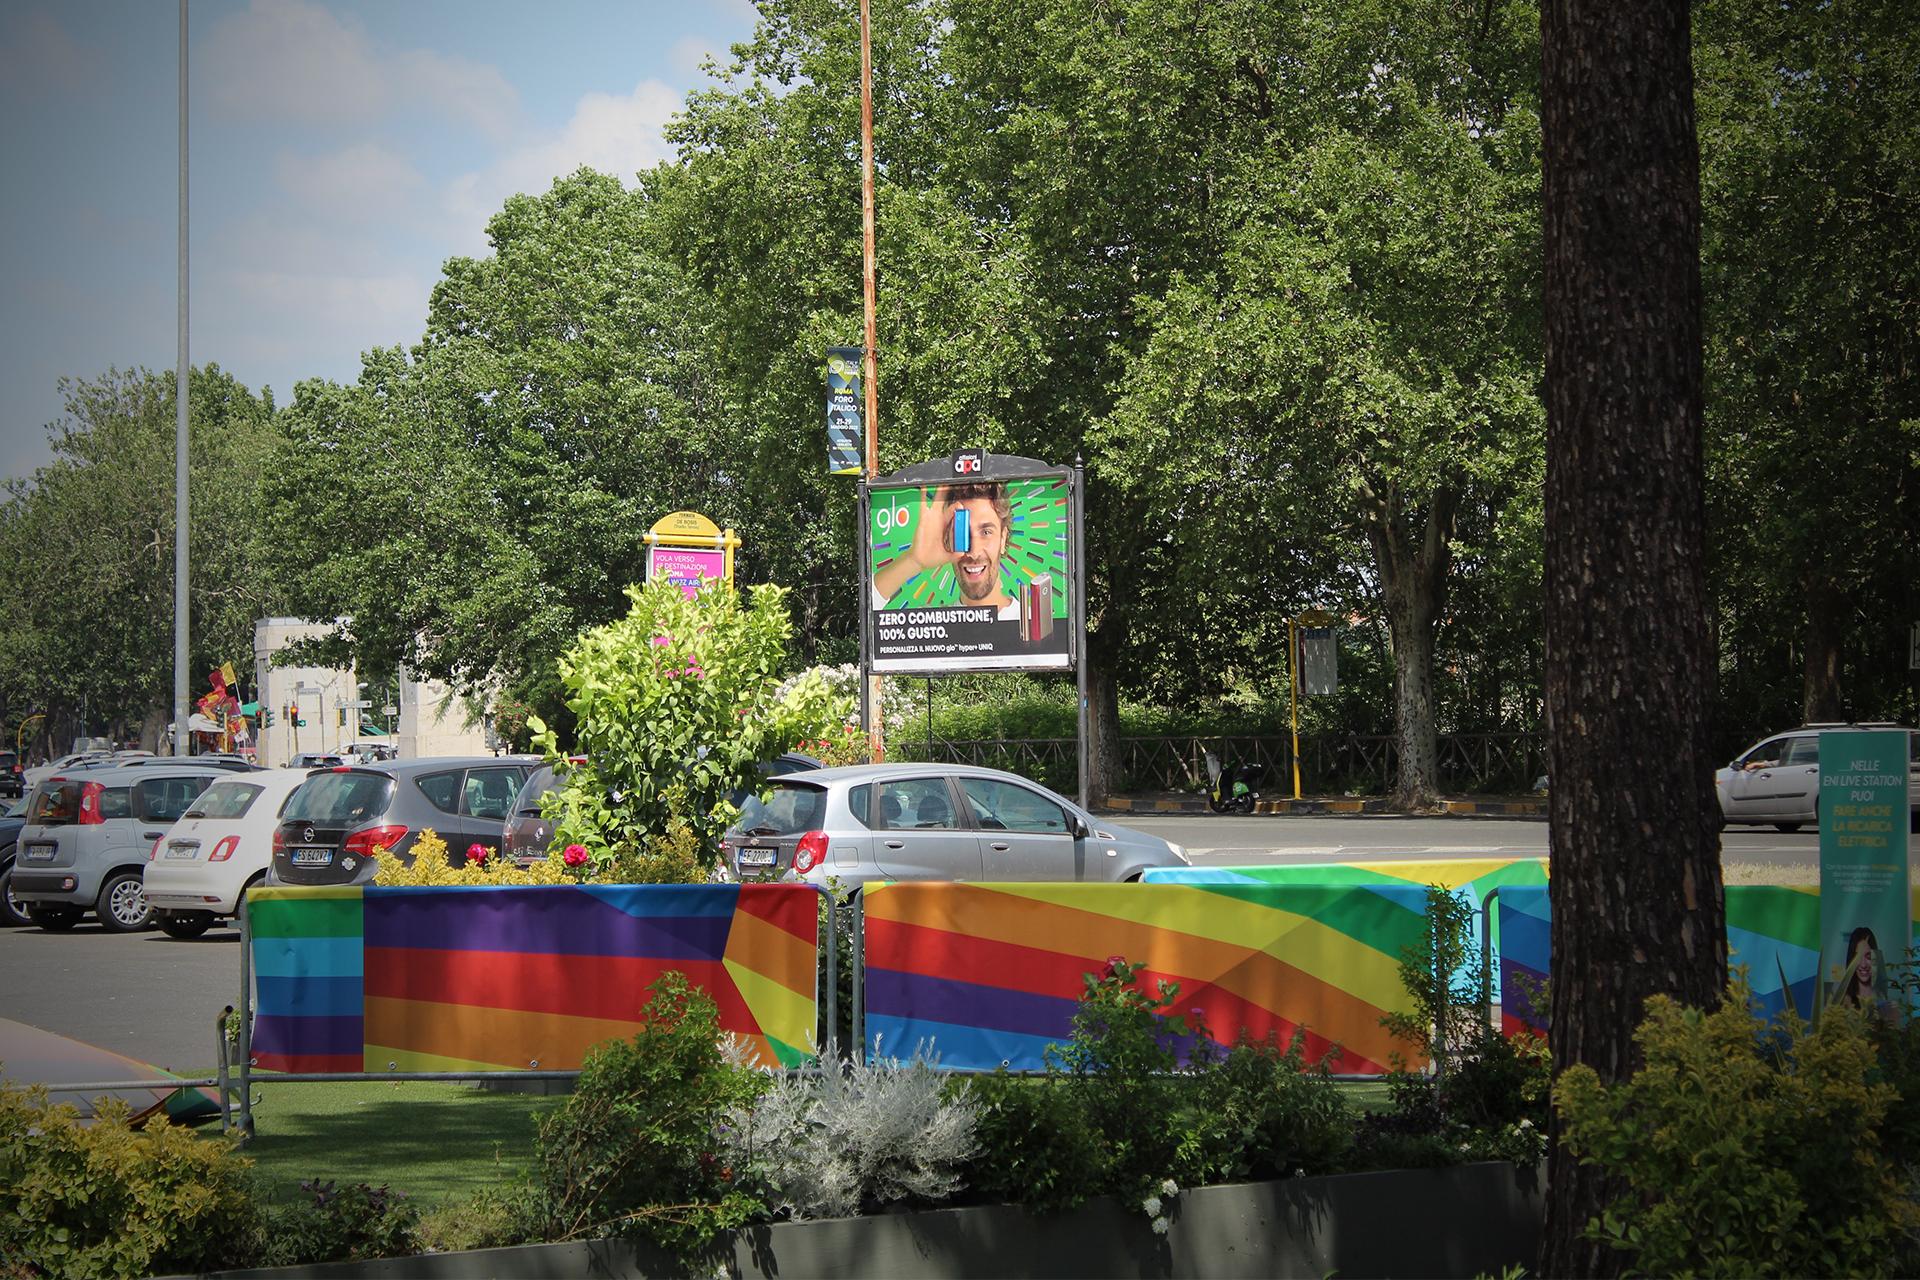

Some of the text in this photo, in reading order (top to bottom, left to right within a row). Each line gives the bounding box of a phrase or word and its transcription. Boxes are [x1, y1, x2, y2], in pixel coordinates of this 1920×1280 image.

[955, 459, 981, 474] apa
[877, 495, 910, 536] glo
[879, 612, 906, 625] ZERO
[879, 626, 948, 641] 100% GUSTO.
[880, 645, 918, 654] PERSONALIZZA
[1824, 775, 1903, 786] ENI LIVE STATION
[1850, 790, 1875, 801] PUOI
[1832, 820, 1845, 832] LA
